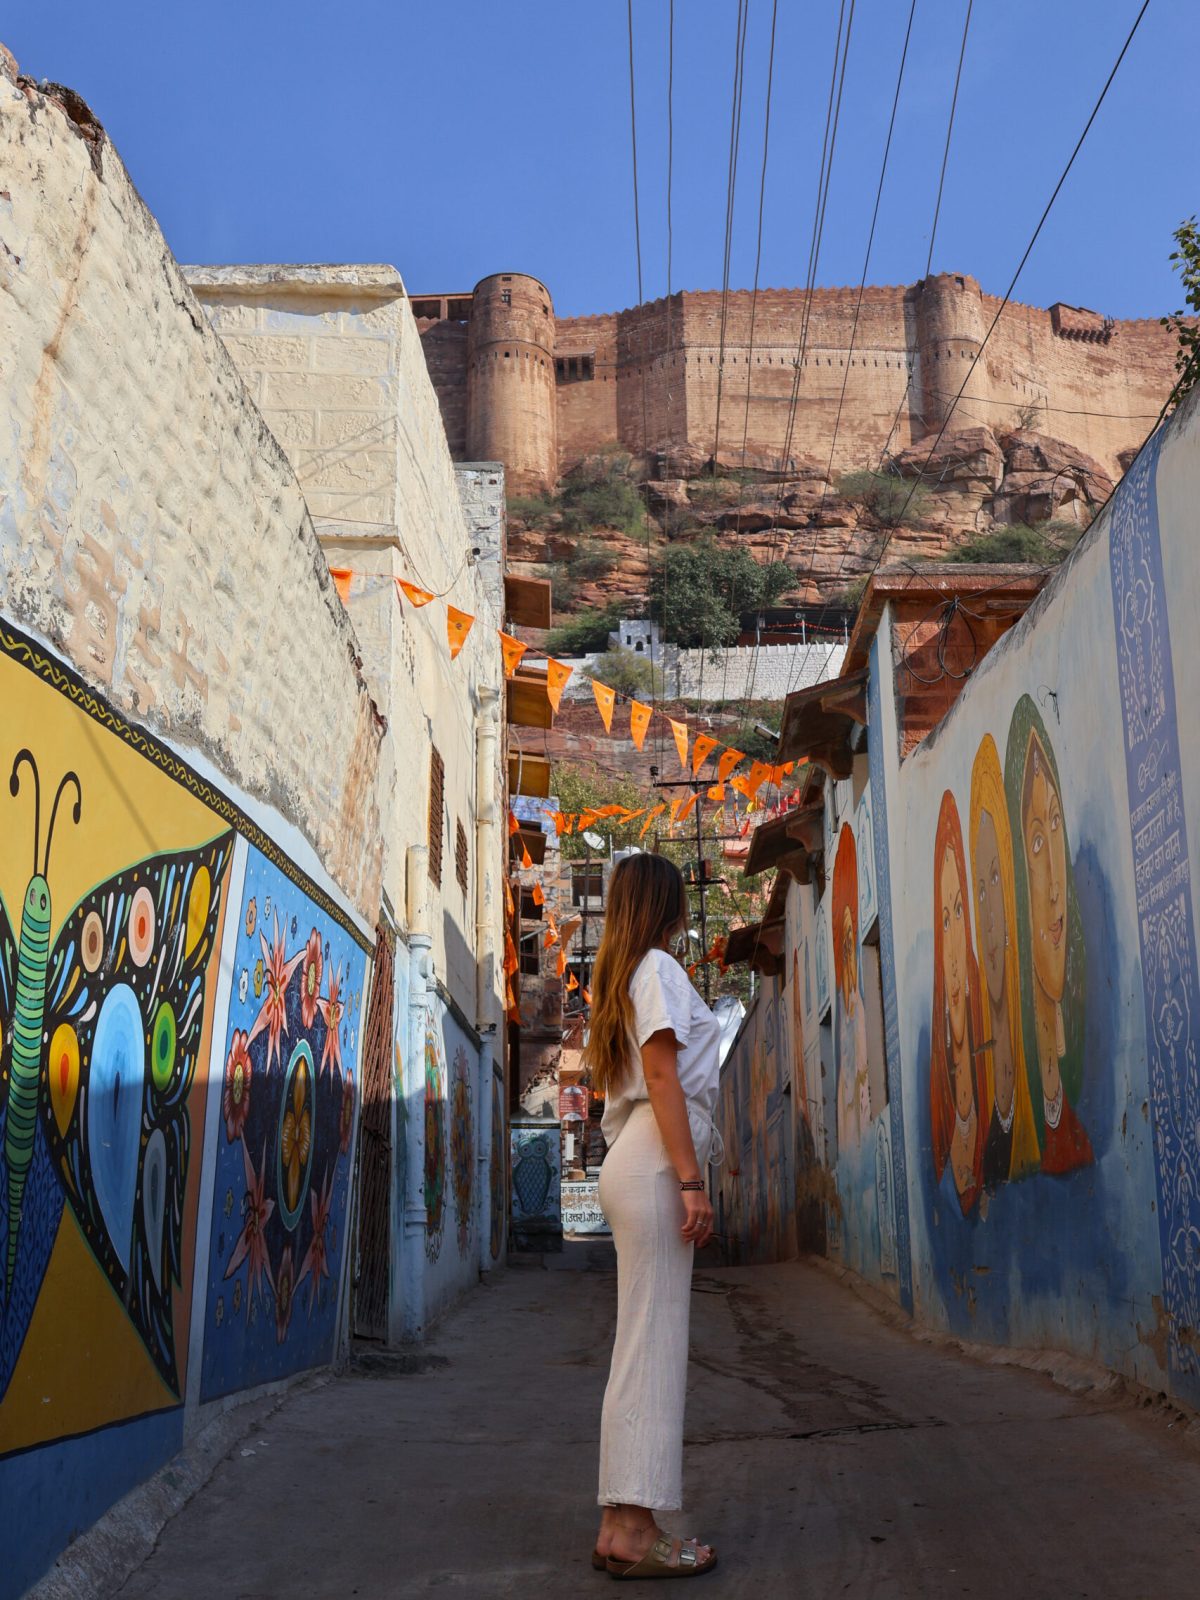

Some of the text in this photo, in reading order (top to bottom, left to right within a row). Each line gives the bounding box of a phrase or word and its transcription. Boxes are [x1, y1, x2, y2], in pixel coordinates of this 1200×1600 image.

[1154, 845, 1164, 870] का
[568, 1186, 586, 1194] कदम
[587, 1210, 608, 1226] जोधपु
